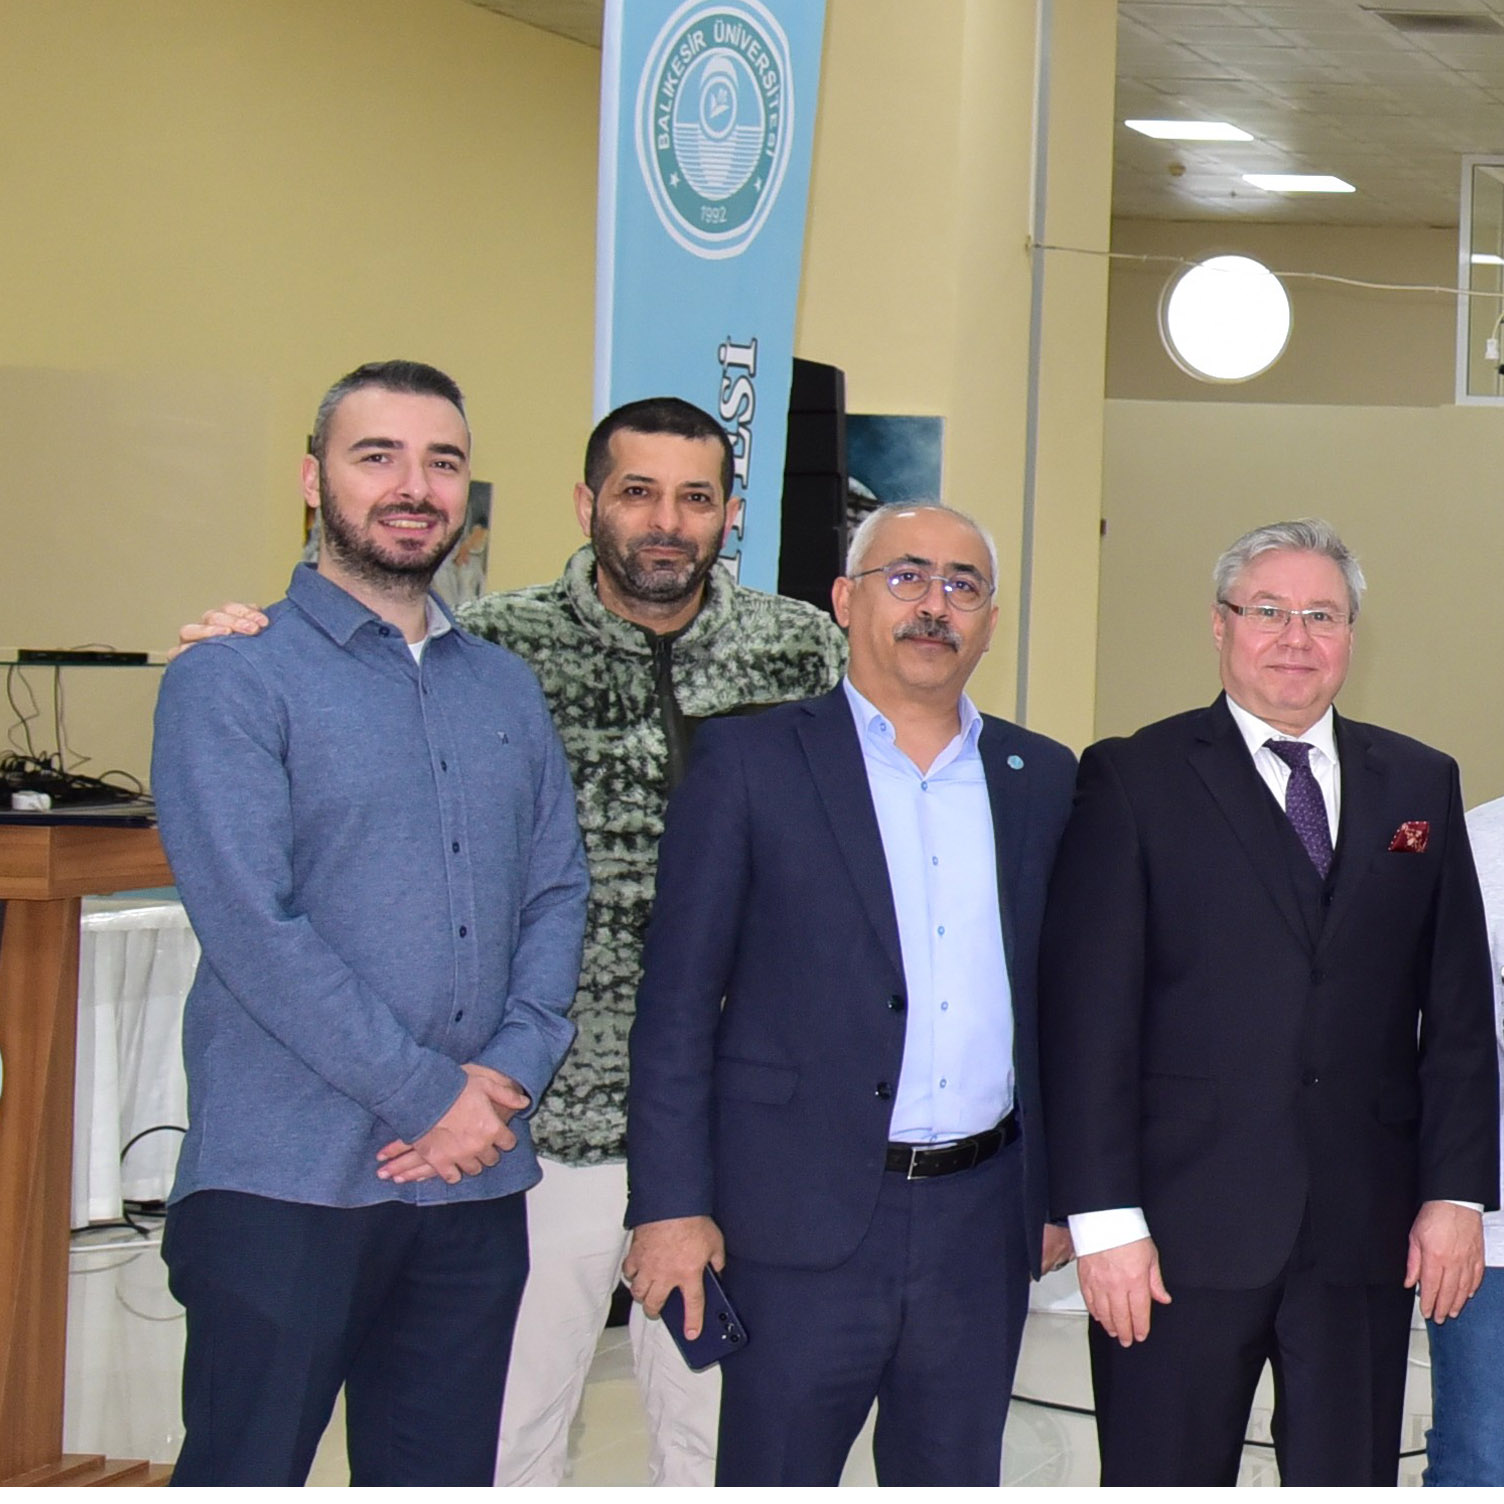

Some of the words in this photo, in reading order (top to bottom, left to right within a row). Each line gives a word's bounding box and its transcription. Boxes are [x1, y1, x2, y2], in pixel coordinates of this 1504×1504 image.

[658, 30, 707, 149] BALIKESİR
[714, 20, 780, 157] ÜNİVERSİTESİ
[701, 206, 727, 223] 1992
